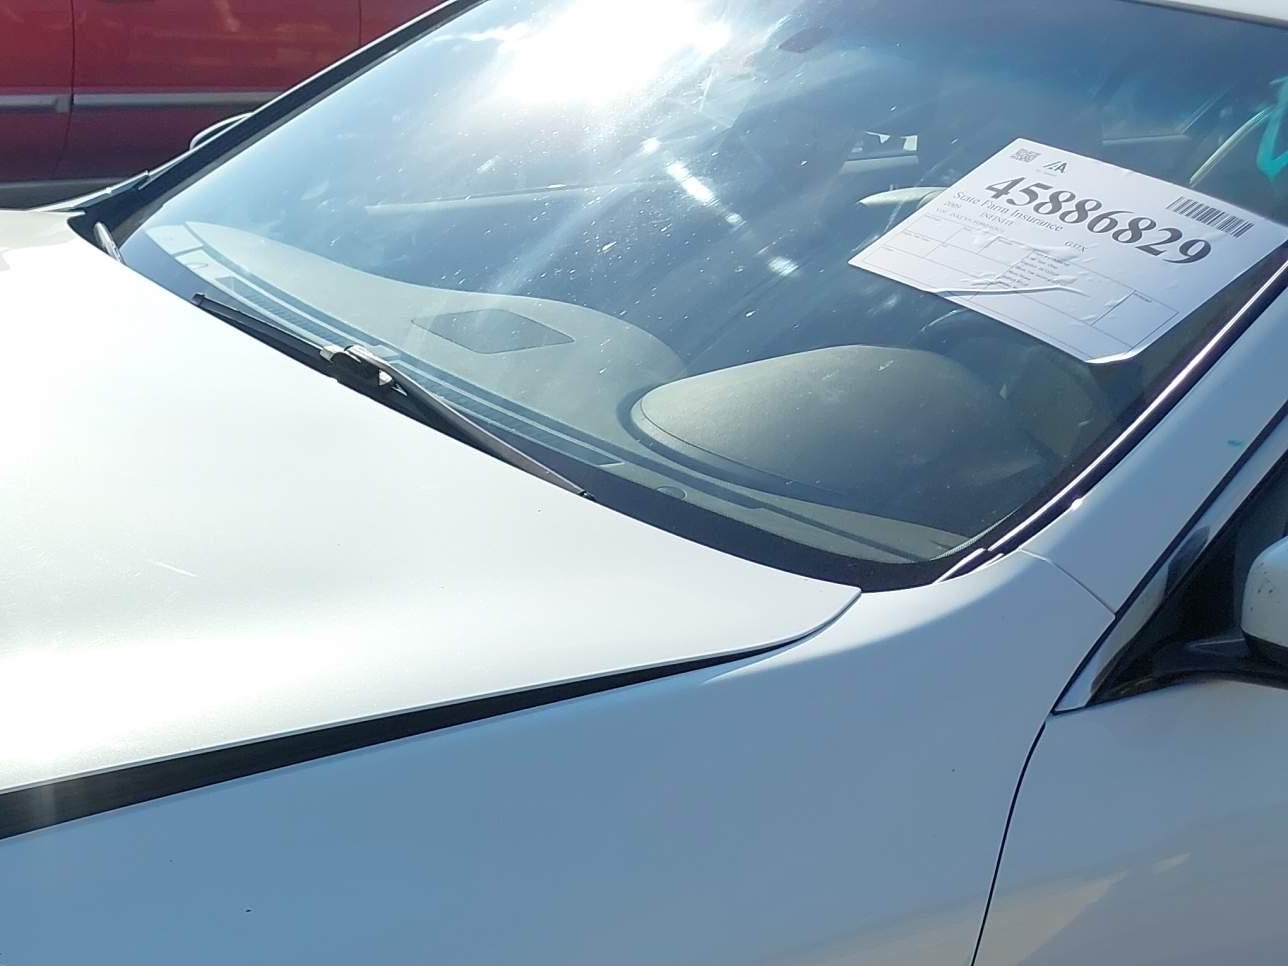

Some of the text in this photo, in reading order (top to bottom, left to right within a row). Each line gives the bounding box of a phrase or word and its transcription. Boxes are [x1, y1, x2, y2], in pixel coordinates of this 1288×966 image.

[953, 191, 981, 205] State
[981, 199, 1008, 215] Farm
[1012, 208, 1063, 232] Insurance
[985, 177, 1212, 264] 45886829
